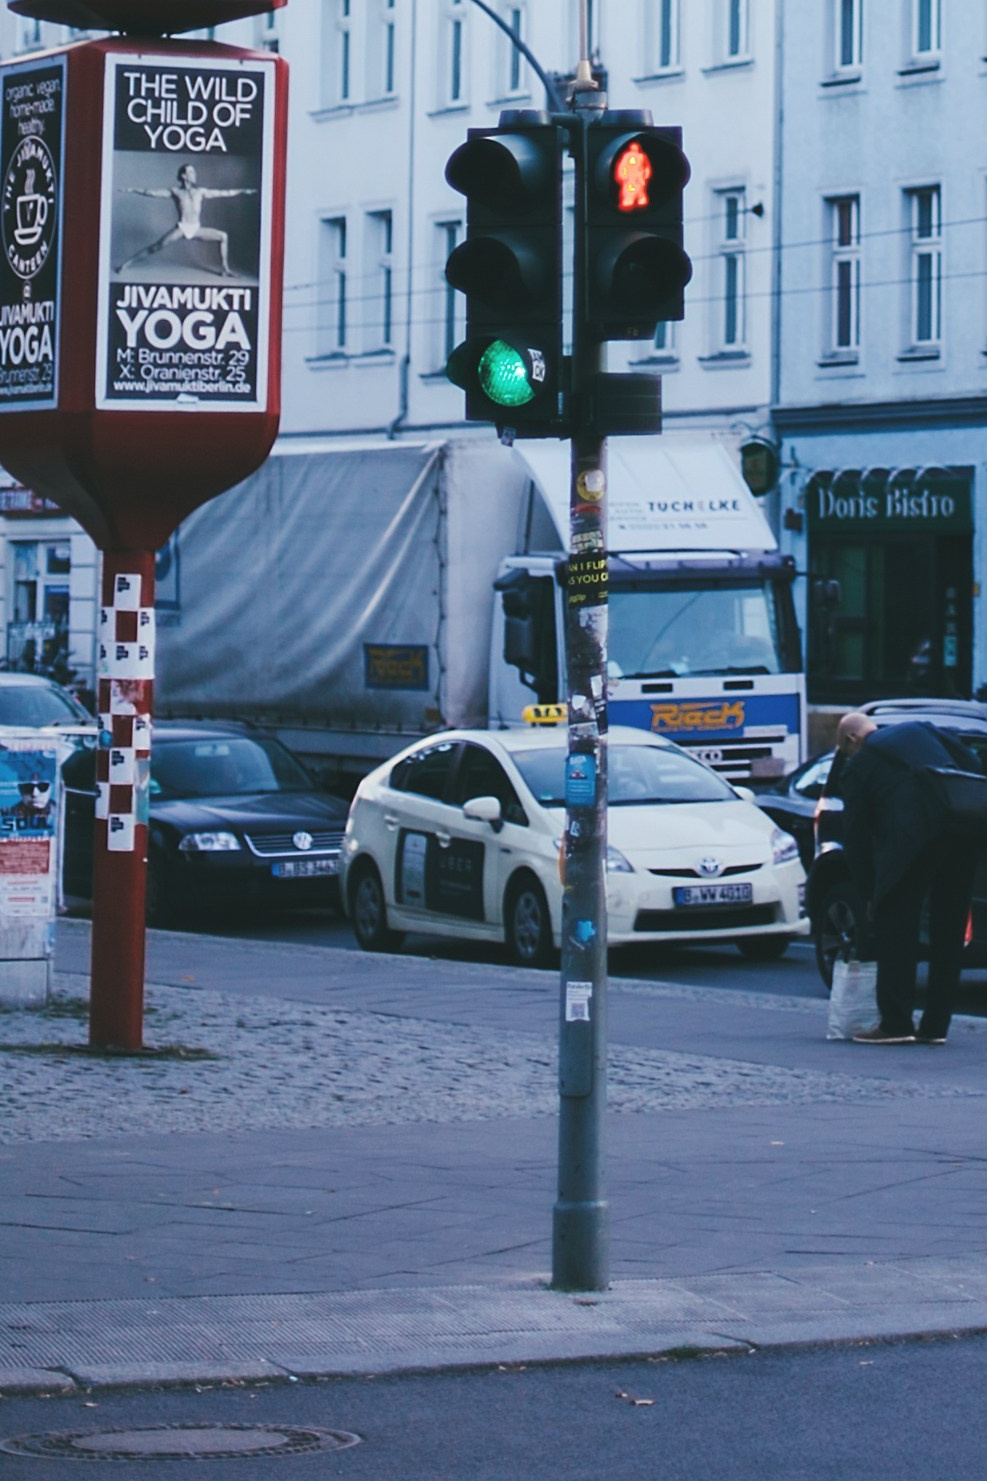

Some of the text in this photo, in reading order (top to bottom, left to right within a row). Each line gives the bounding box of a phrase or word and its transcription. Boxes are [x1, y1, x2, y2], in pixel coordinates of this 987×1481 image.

[123, 72, 257, 102] THE WILD
[127, 98, 253, 127] CHILD OF
[143, 124, 227, 152] YOGA
[8, 240, 48, 273] CANTEEN
[116, 285, 252, 311] JIVAMUKTI
[0, 301, 54, 326] JIVAMUKTI
[115, 309, 252, 350] YOGA
[0, 324, 53, 365] YOGA
[117, 348, 250, 367] M: Brunnenstr. 29
[113, 379, 252, 394] www.jivamuktiberlin.de
[119, 364, 246, 382] X: Oranienstr. 25
[818, 488, 956, 518] Doris Bistro
